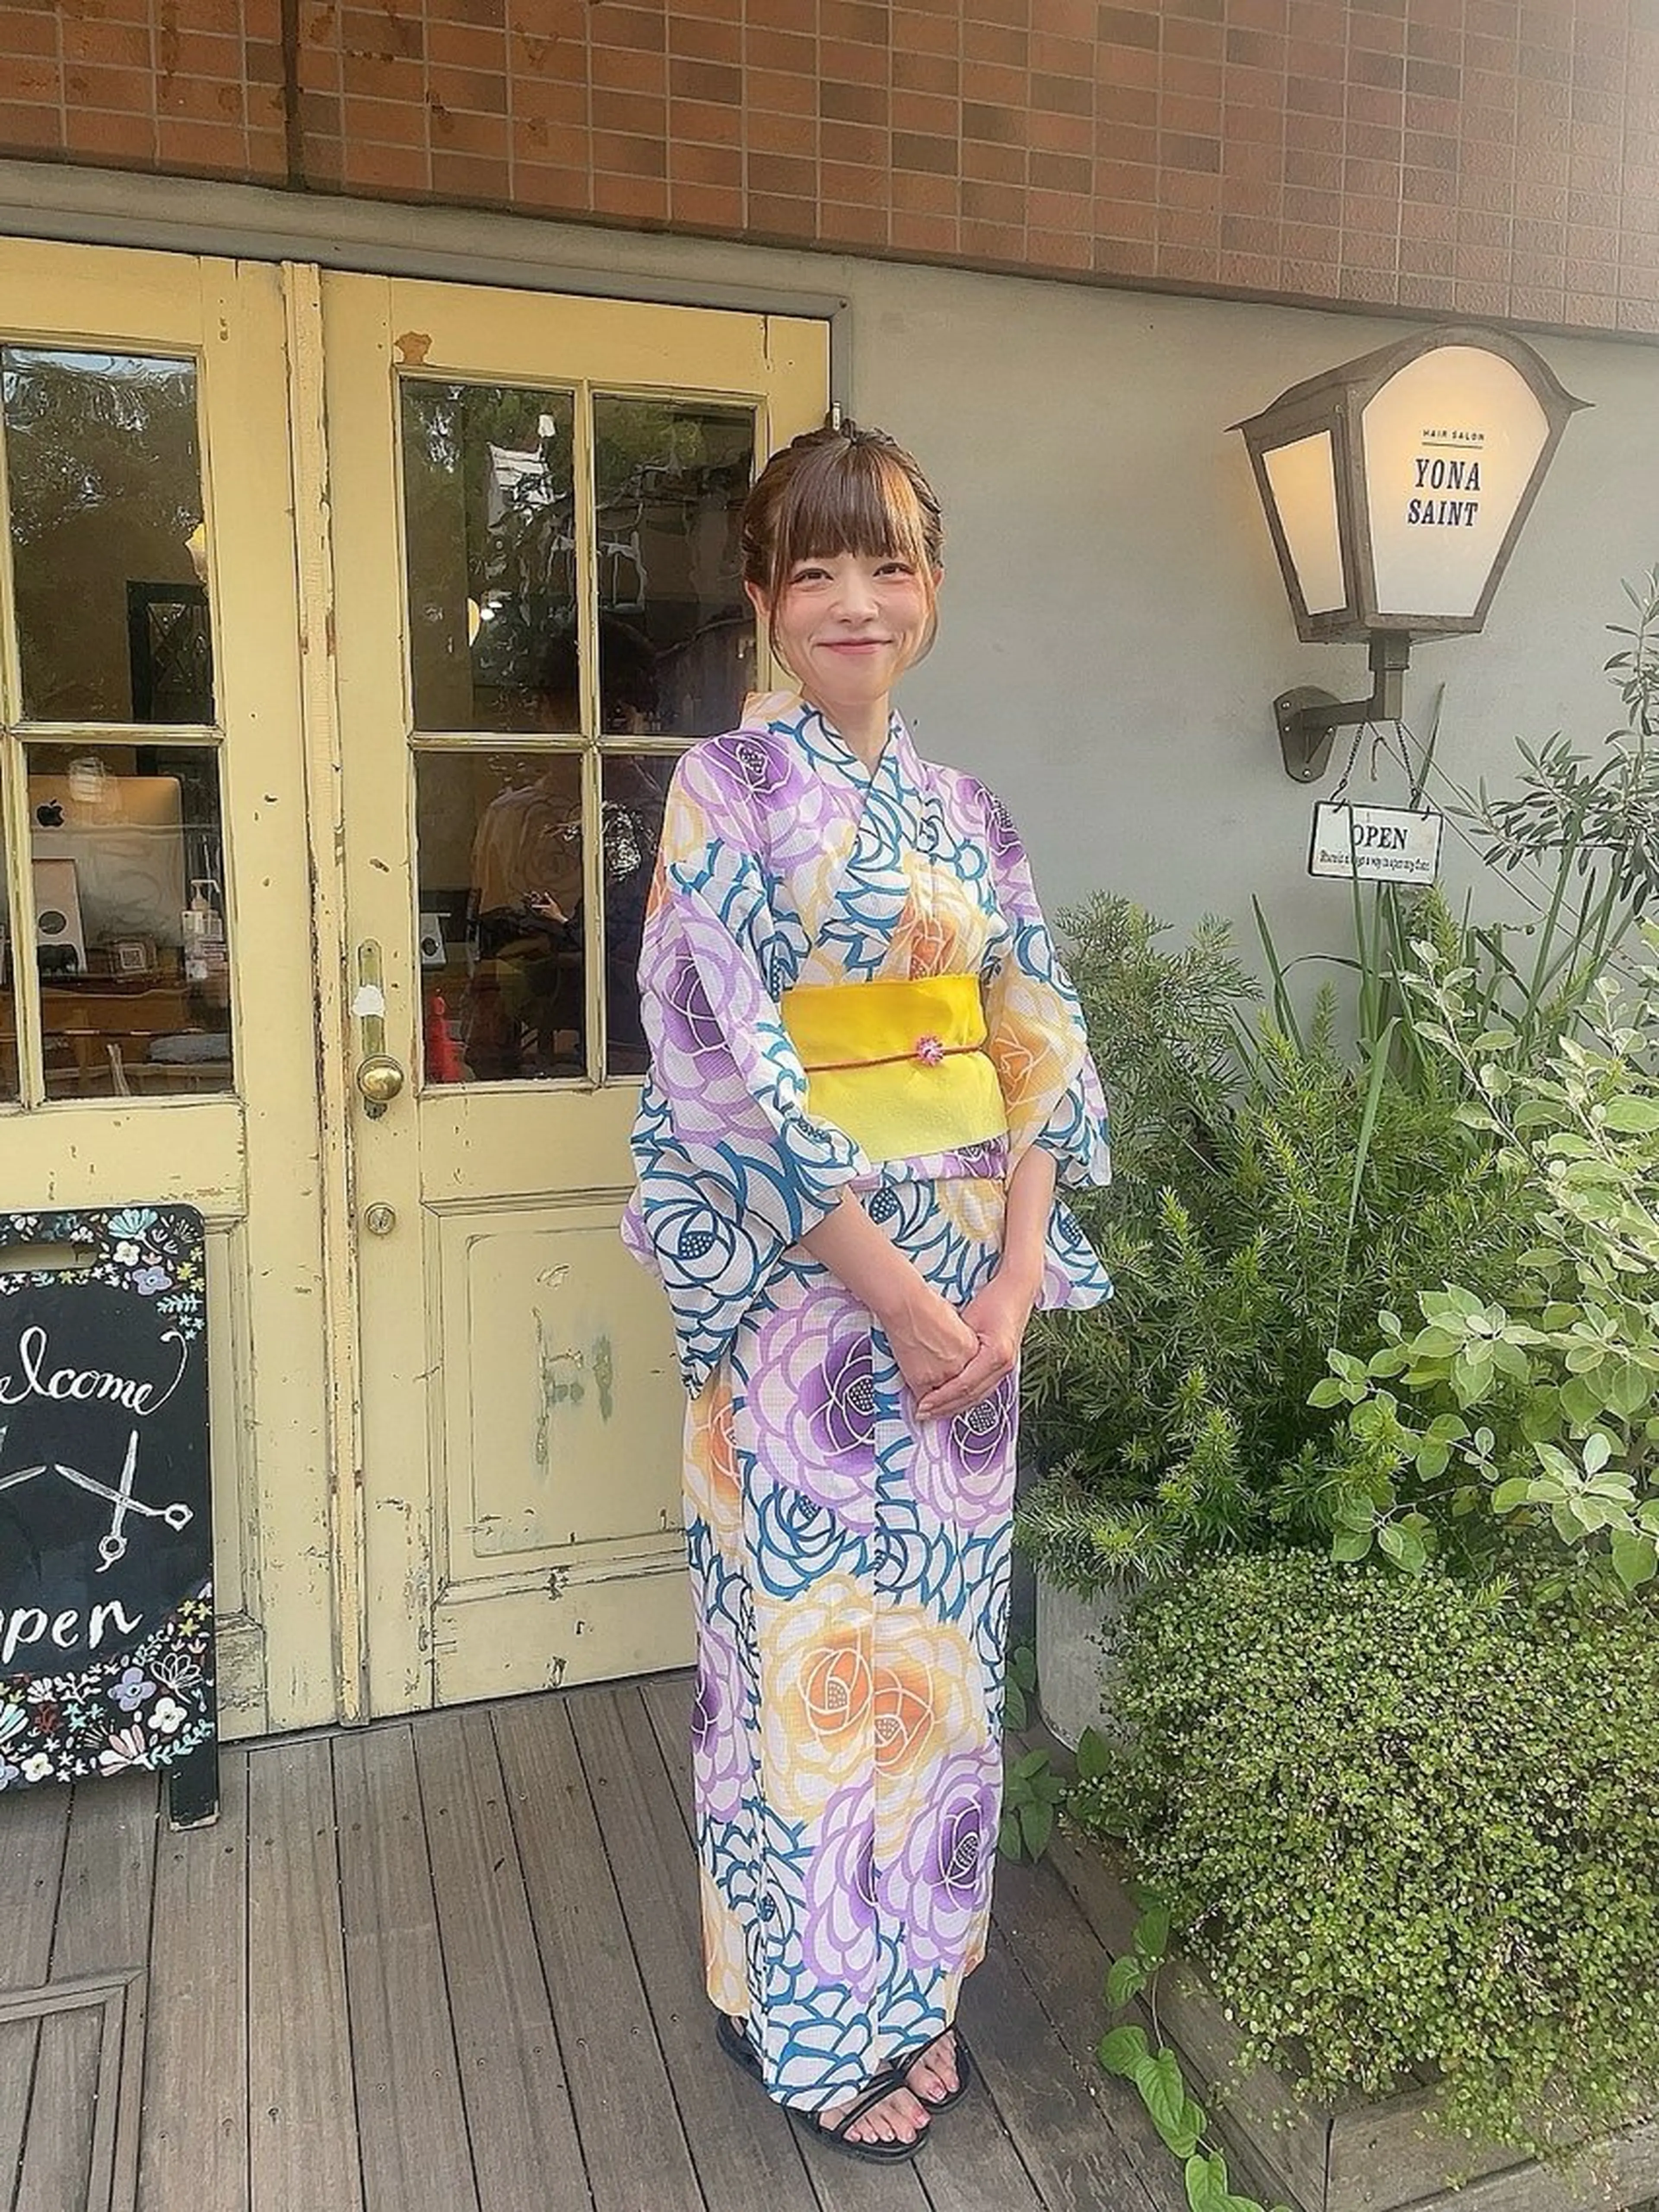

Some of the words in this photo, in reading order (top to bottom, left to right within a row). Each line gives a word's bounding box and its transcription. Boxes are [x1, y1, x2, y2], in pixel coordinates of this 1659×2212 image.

[1423, 429, 1447, 438] HAIR
[1452, 430, 1484, 441] SALON
[1415, 458, 1481, 491] YONA
[1408, 499, 1478, 526] SAINT
[1351, 824, 1408, 850] OPEN
[0, 1600, 143, 1664] pen
